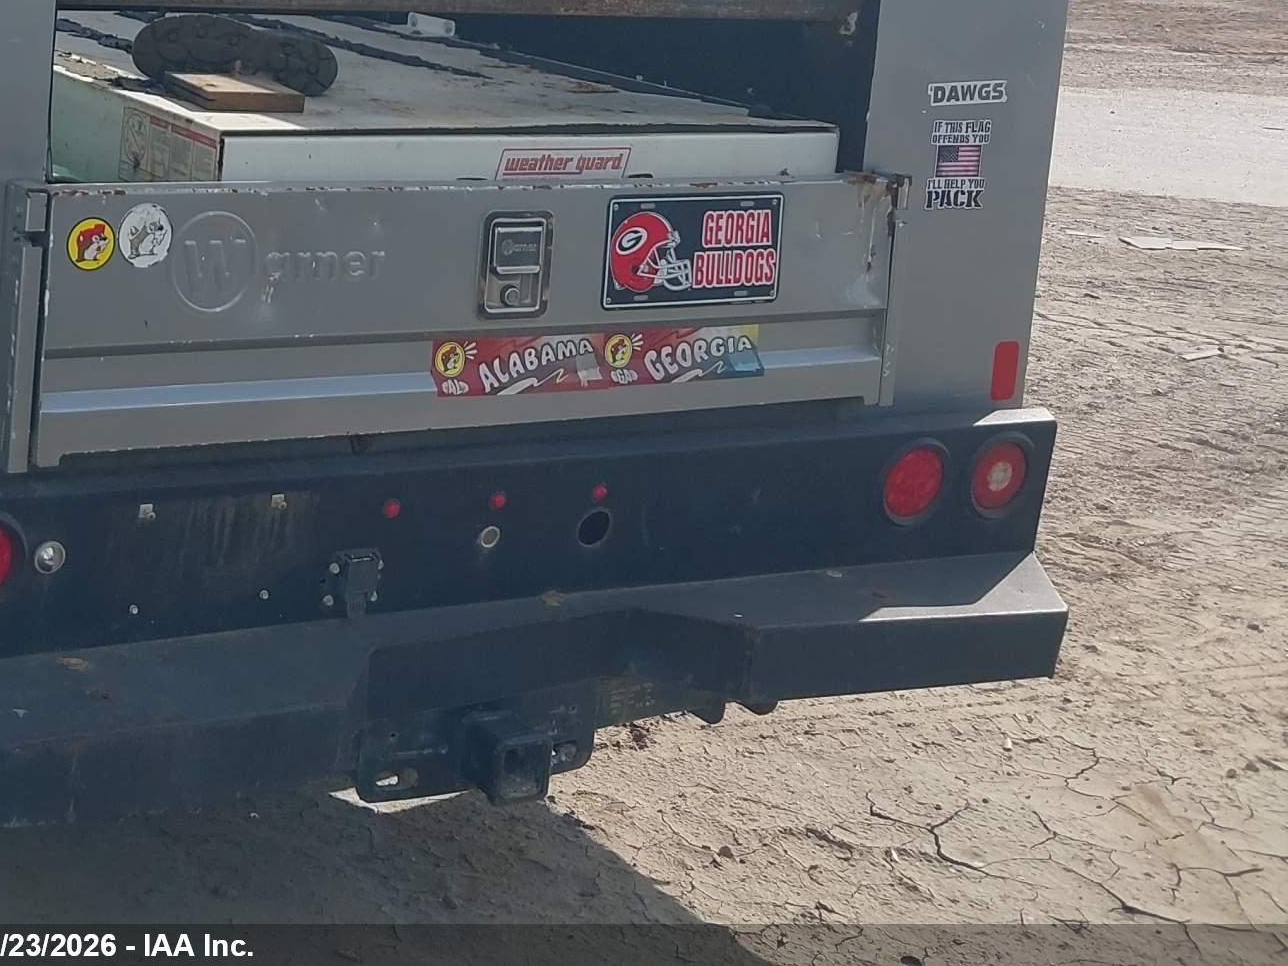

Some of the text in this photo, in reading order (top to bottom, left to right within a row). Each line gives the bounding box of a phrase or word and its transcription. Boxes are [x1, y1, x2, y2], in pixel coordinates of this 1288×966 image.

[965, 120, 991, 133] FLAG
[932, 133, 990, 144] OFFENDS YOU
[504, 156, 573, 171] weather
[944, 179, 967, 190] HELP
[969, 178, 985, 189] YOU
[926, 190, 983, 208] PACK
[702, 210, 772, 248] GEORGIA
[693, 249, 776, 289] BULLDOGS
[478, 338, 594, 394] ALABAMA
[644, 335, 753, 381] GEORGIA
